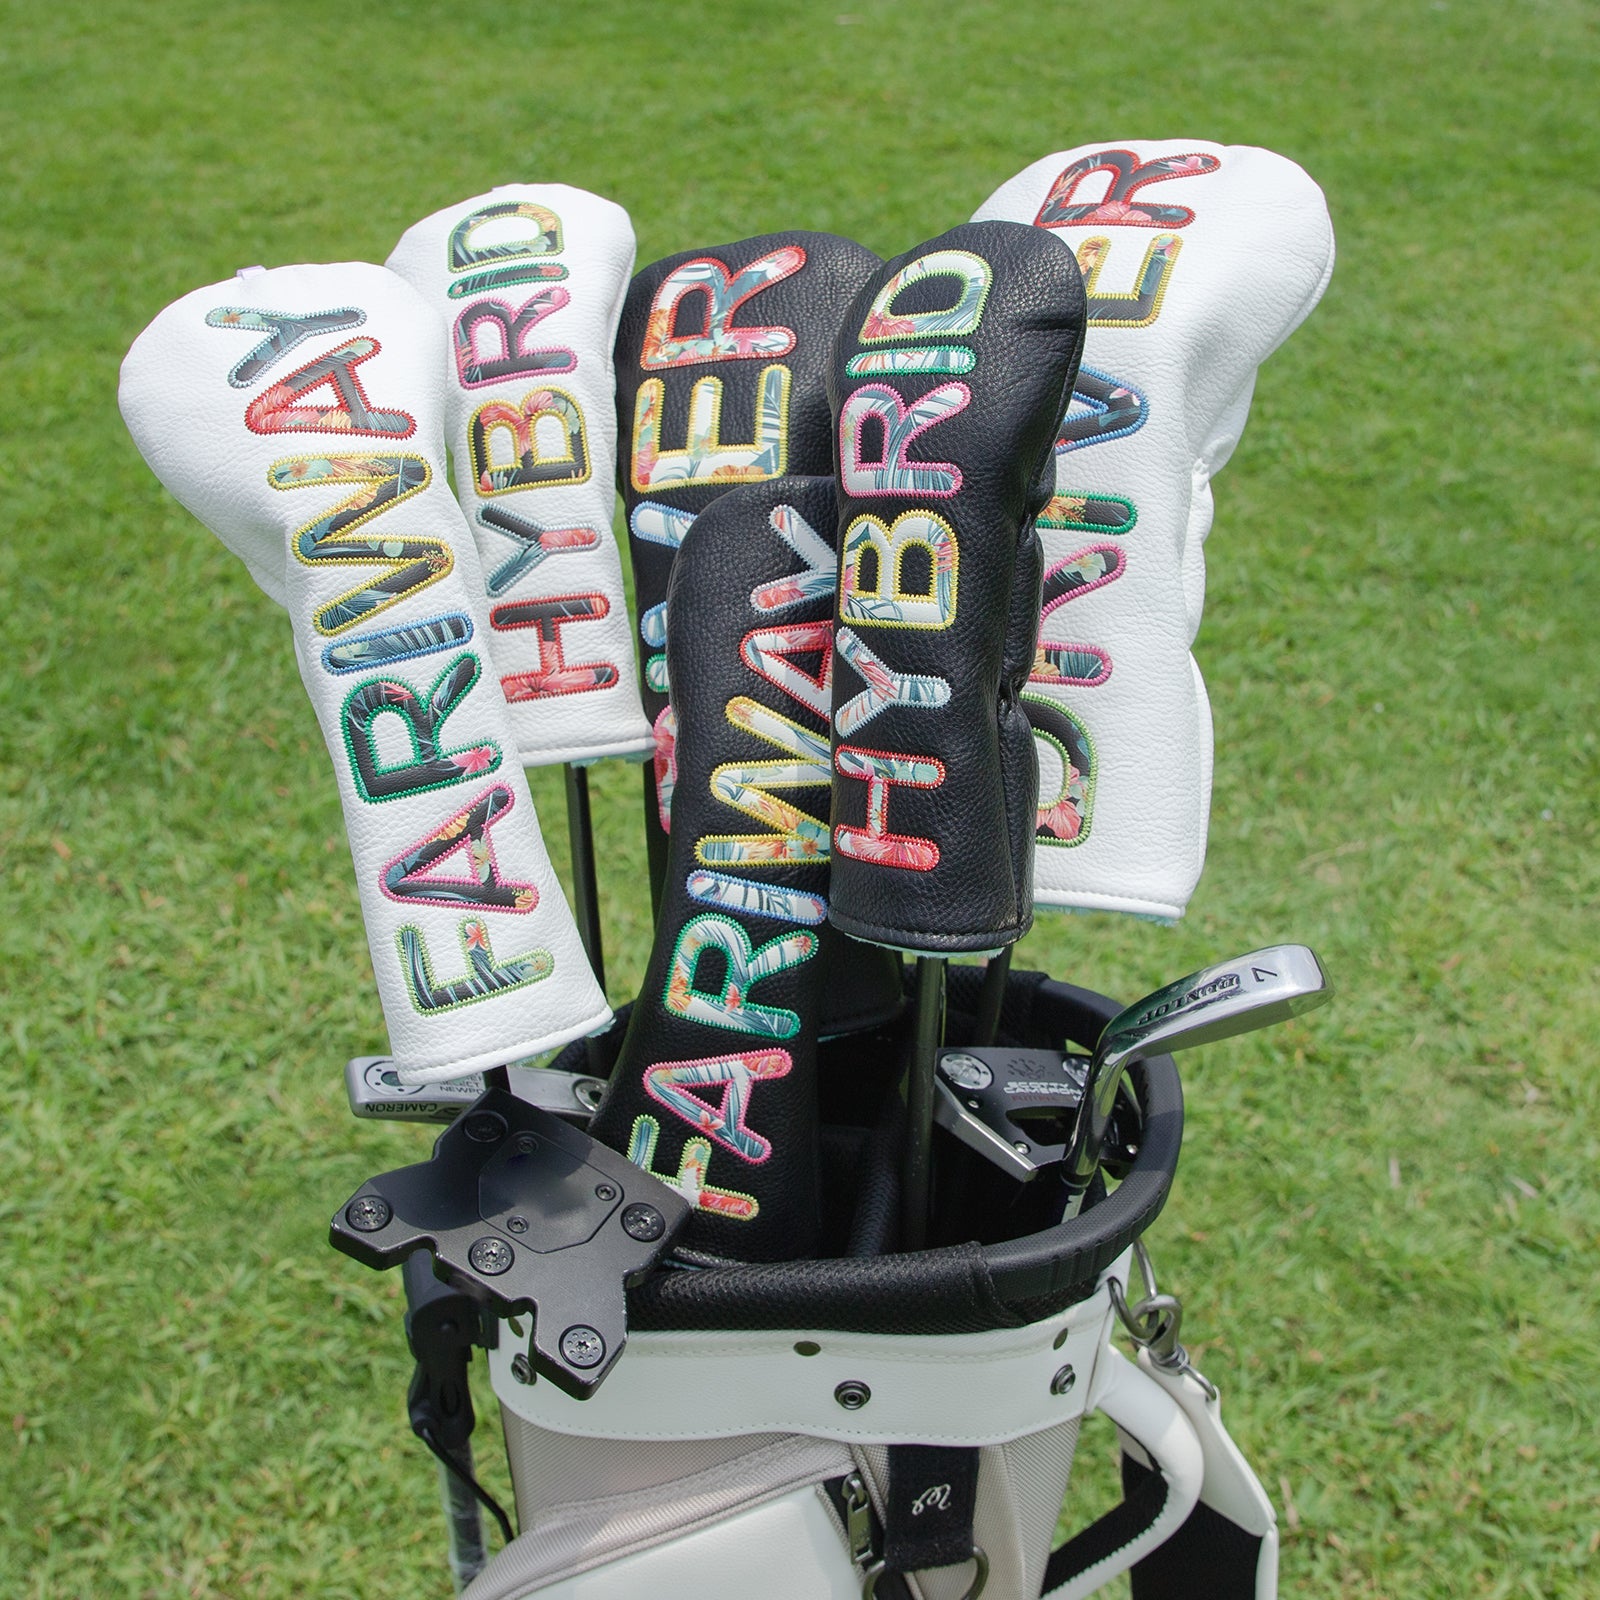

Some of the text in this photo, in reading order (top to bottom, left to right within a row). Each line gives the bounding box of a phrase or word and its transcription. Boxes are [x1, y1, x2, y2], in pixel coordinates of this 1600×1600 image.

[205, 306, 555, 1016] FARIWAY
[448, 200, 620, 702] HYBRID
[833, 249, 993, 872] HYBRID
[365, 1103, 438, 1112] CAMERON
[1137, 974, 1239, 1026] DUNLOP
